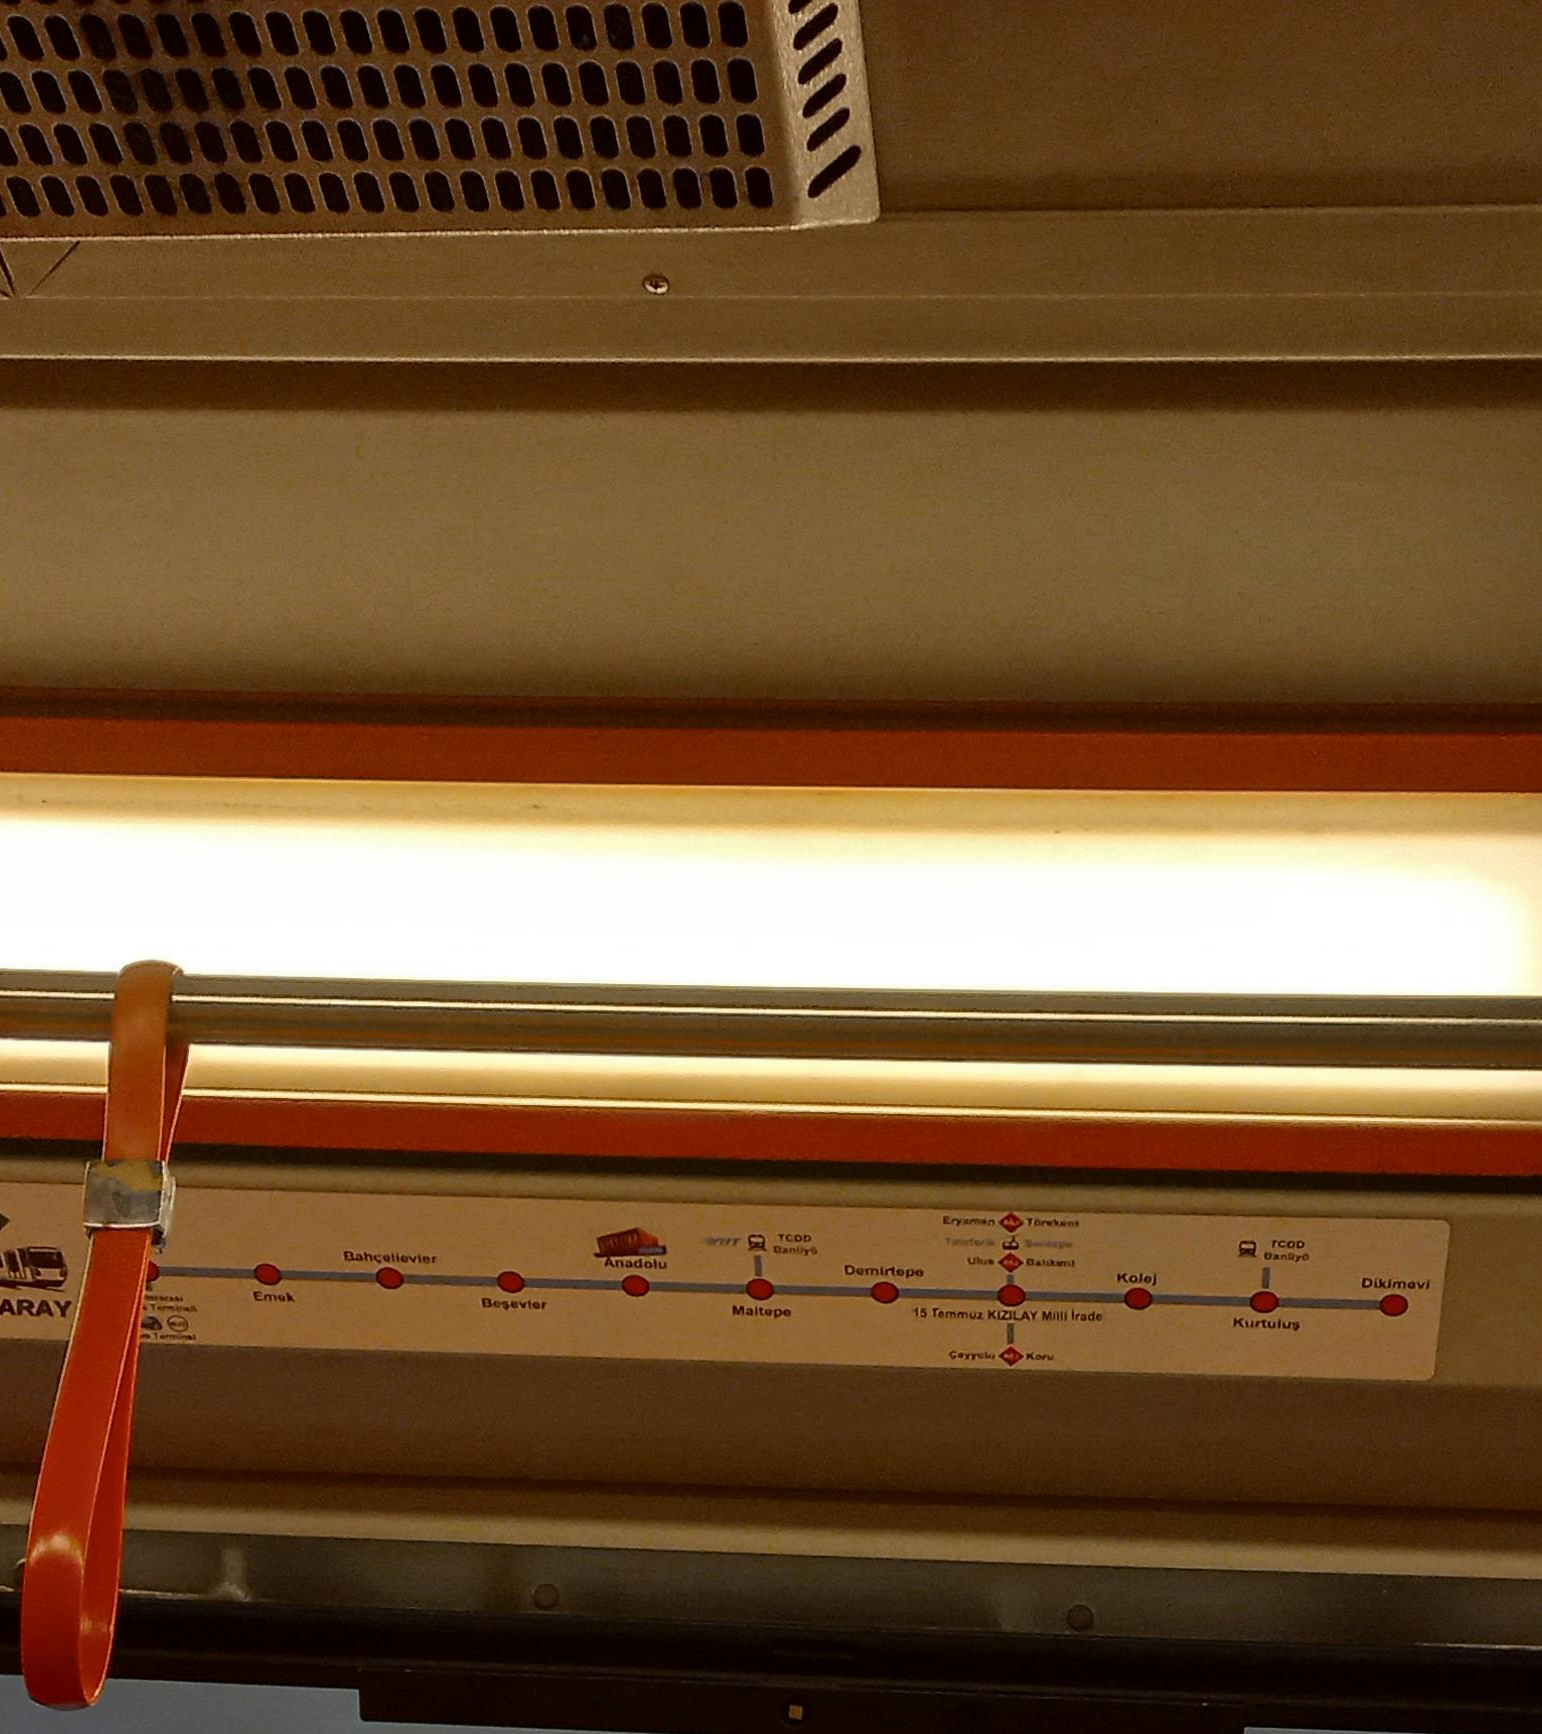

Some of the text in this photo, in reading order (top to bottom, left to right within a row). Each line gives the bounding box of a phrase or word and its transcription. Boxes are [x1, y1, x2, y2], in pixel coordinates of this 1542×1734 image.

[777, 1232, 812, 1243] TCDD
[343, 1250, 438, 1265] Bahçelievler
[604, 1257, 667, 1270] Anadolu
[844, 1264, 924, 1279] Demirtepe
[1116, 1272, 1158, 1285] Kolej
[1361, 1276, 1431, 1290] Dikimevi
[253, 1291, 296, 1304] Emek
[481, 1297, 548, 1311] Beşevler
[732, 1304, 792, 1319] Maltepe
[913, 1307, 1104, 1322] 15 Temmuz KIZILAY Milli İrade
[1232, 1317, 1301, 1332] Kurtuluş
